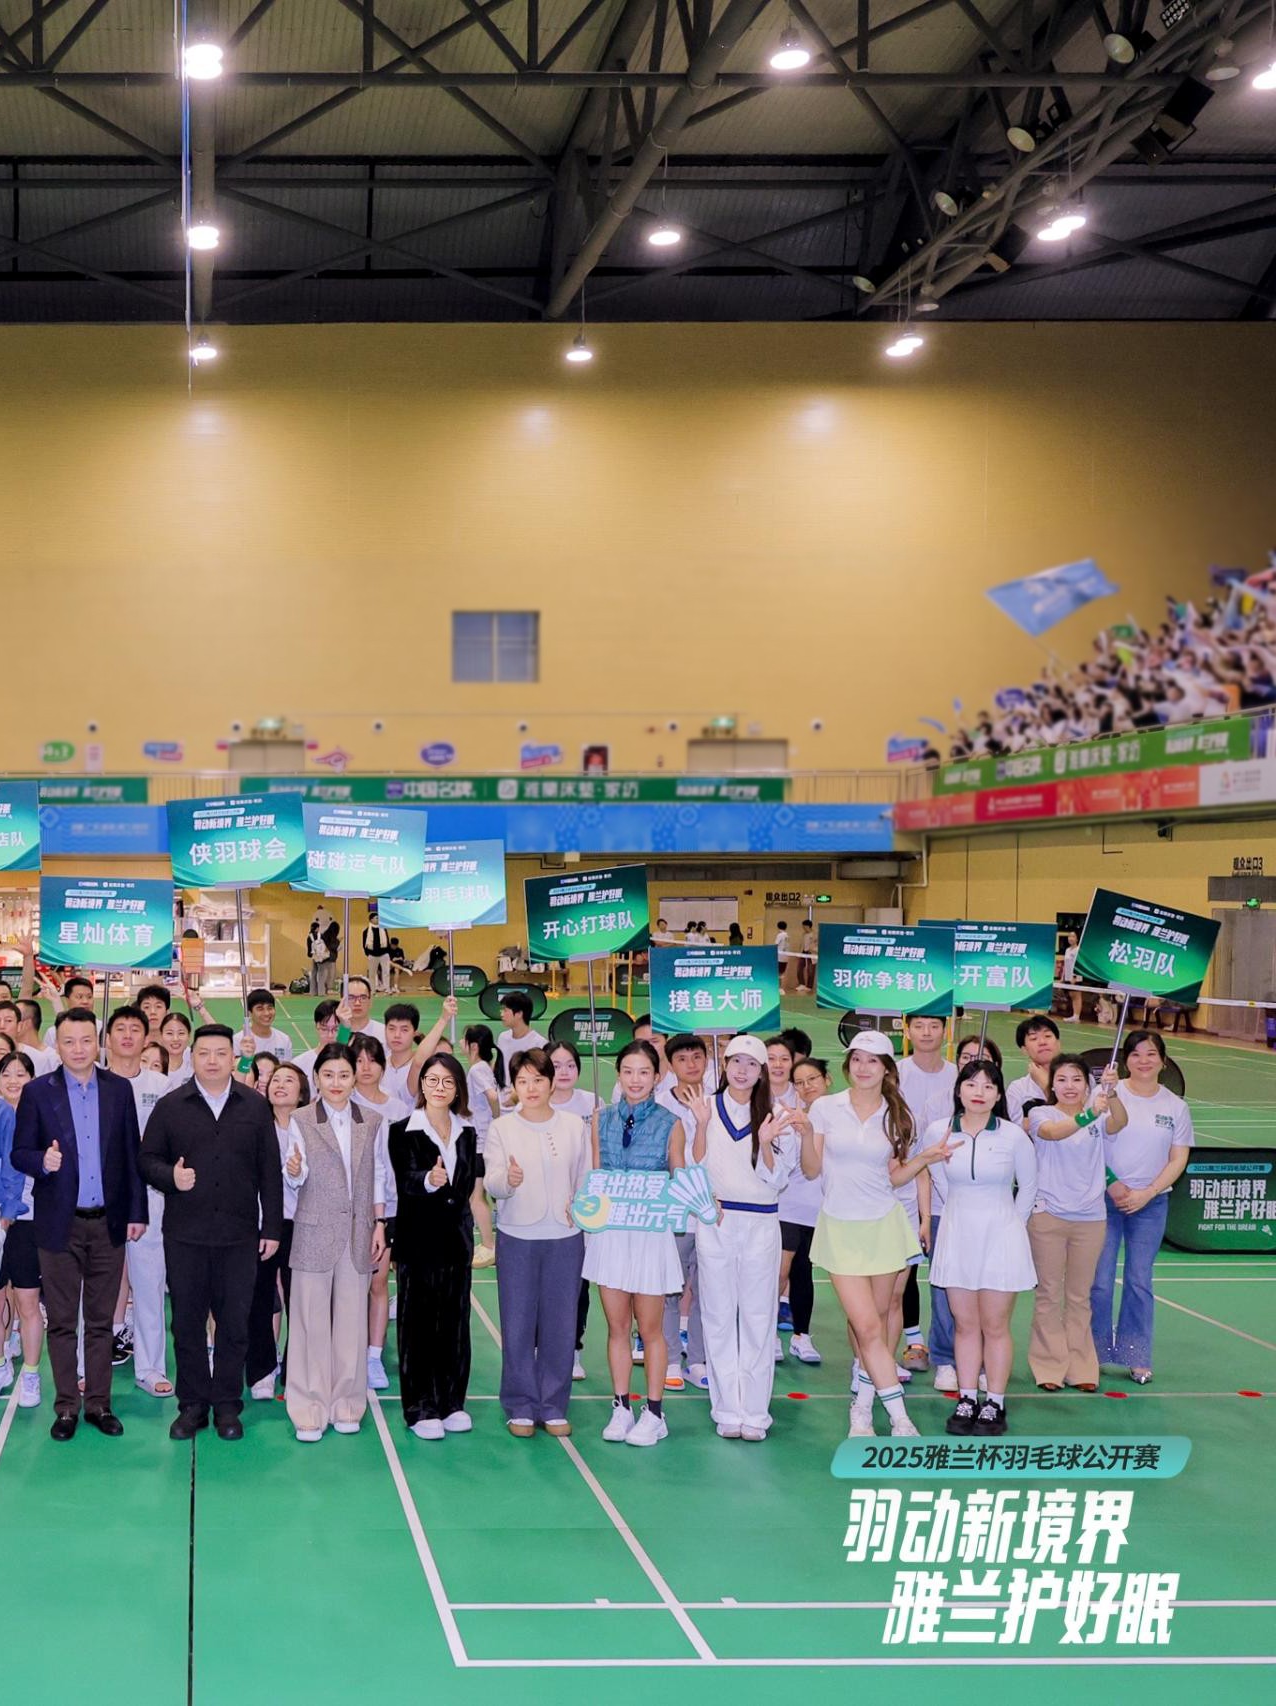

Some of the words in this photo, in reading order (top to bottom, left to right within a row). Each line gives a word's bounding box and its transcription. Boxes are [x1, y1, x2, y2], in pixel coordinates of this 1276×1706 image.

[189, 837, 286, 866] 侠羽球会
[307, 850, 407, 875] 碰碰运气队
[390, 885, 492, 904] 羽毛球队
[58, 921, 155, 947] 星灿体育
[543, 910, 635, 940] 开心打球队
[1108, 939, 1175, 978] 松羽队
[832, 968, 936, 993] 羽你争锋队
[954, 965, 1035, 988] 开富队
[669, 988, 763, 1013] 摸鱼大师
[1190, 1179, 1267, 1199] 羽动新境界
[607, 1201, 687, 1230] 睡出元气
